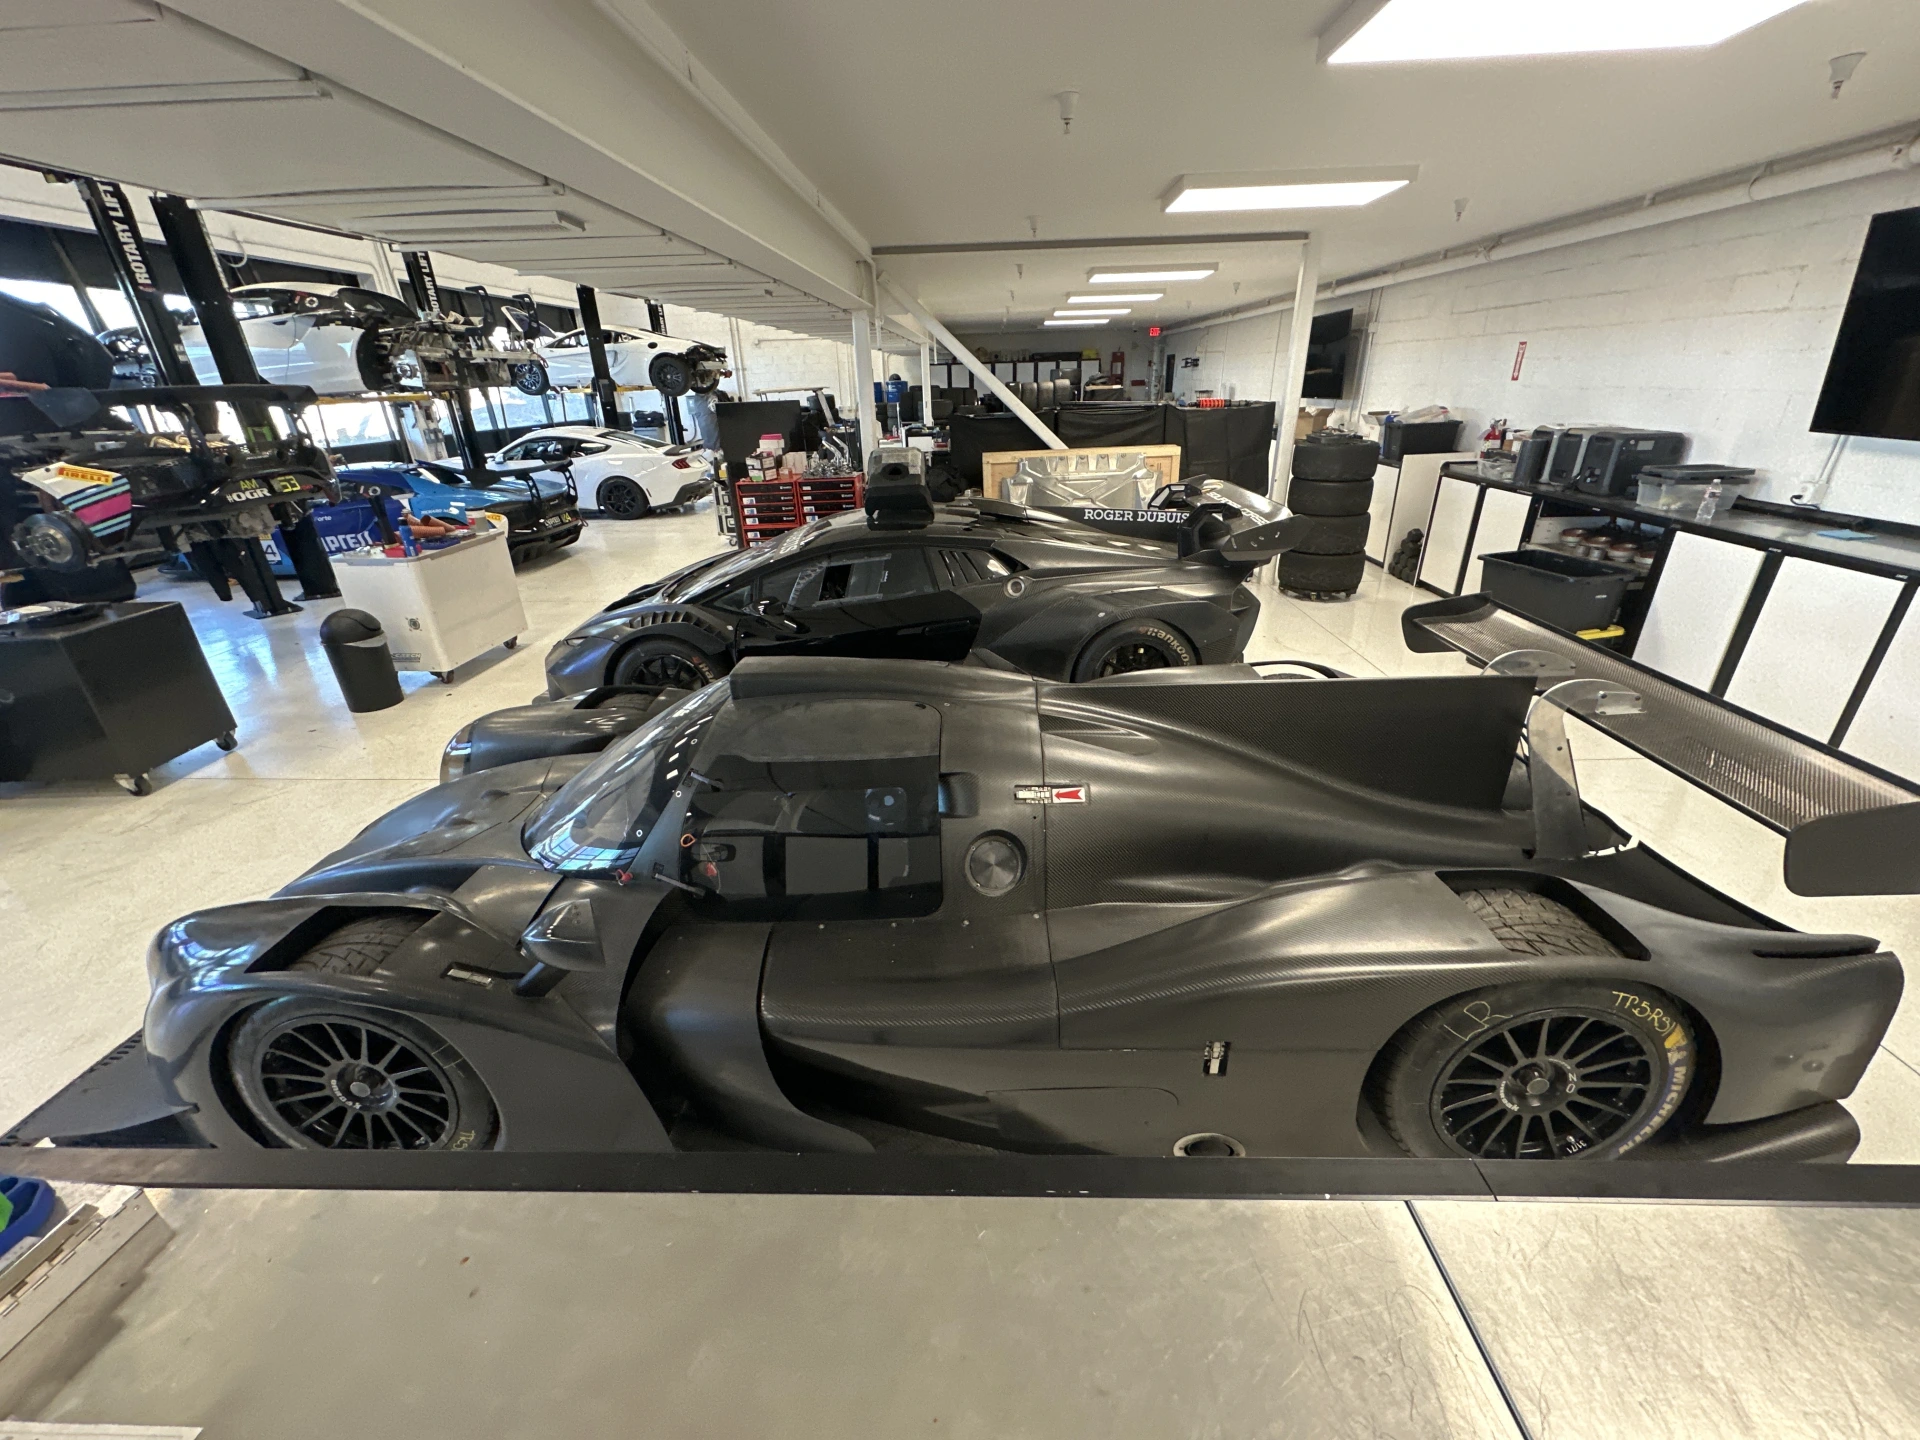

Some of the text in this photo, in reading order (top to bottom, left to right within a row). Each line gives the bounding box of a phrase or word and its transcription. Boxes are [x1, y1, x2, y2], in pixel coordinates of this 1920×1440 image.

[96, 181, 152, 285] ROTARY LIFT
[422, 274, 441, 312] OTARY
[58, 467, 112, 484] PIRELLI
[239, 478, 259, 490] AM
[225, 488, 272, 503] #OGR
[1083, 508, 1134, 521] ROGER
[1146, 627, 1190, 666] Hankoo
[1618, 1065, 1688, 1154] MICHELIN
